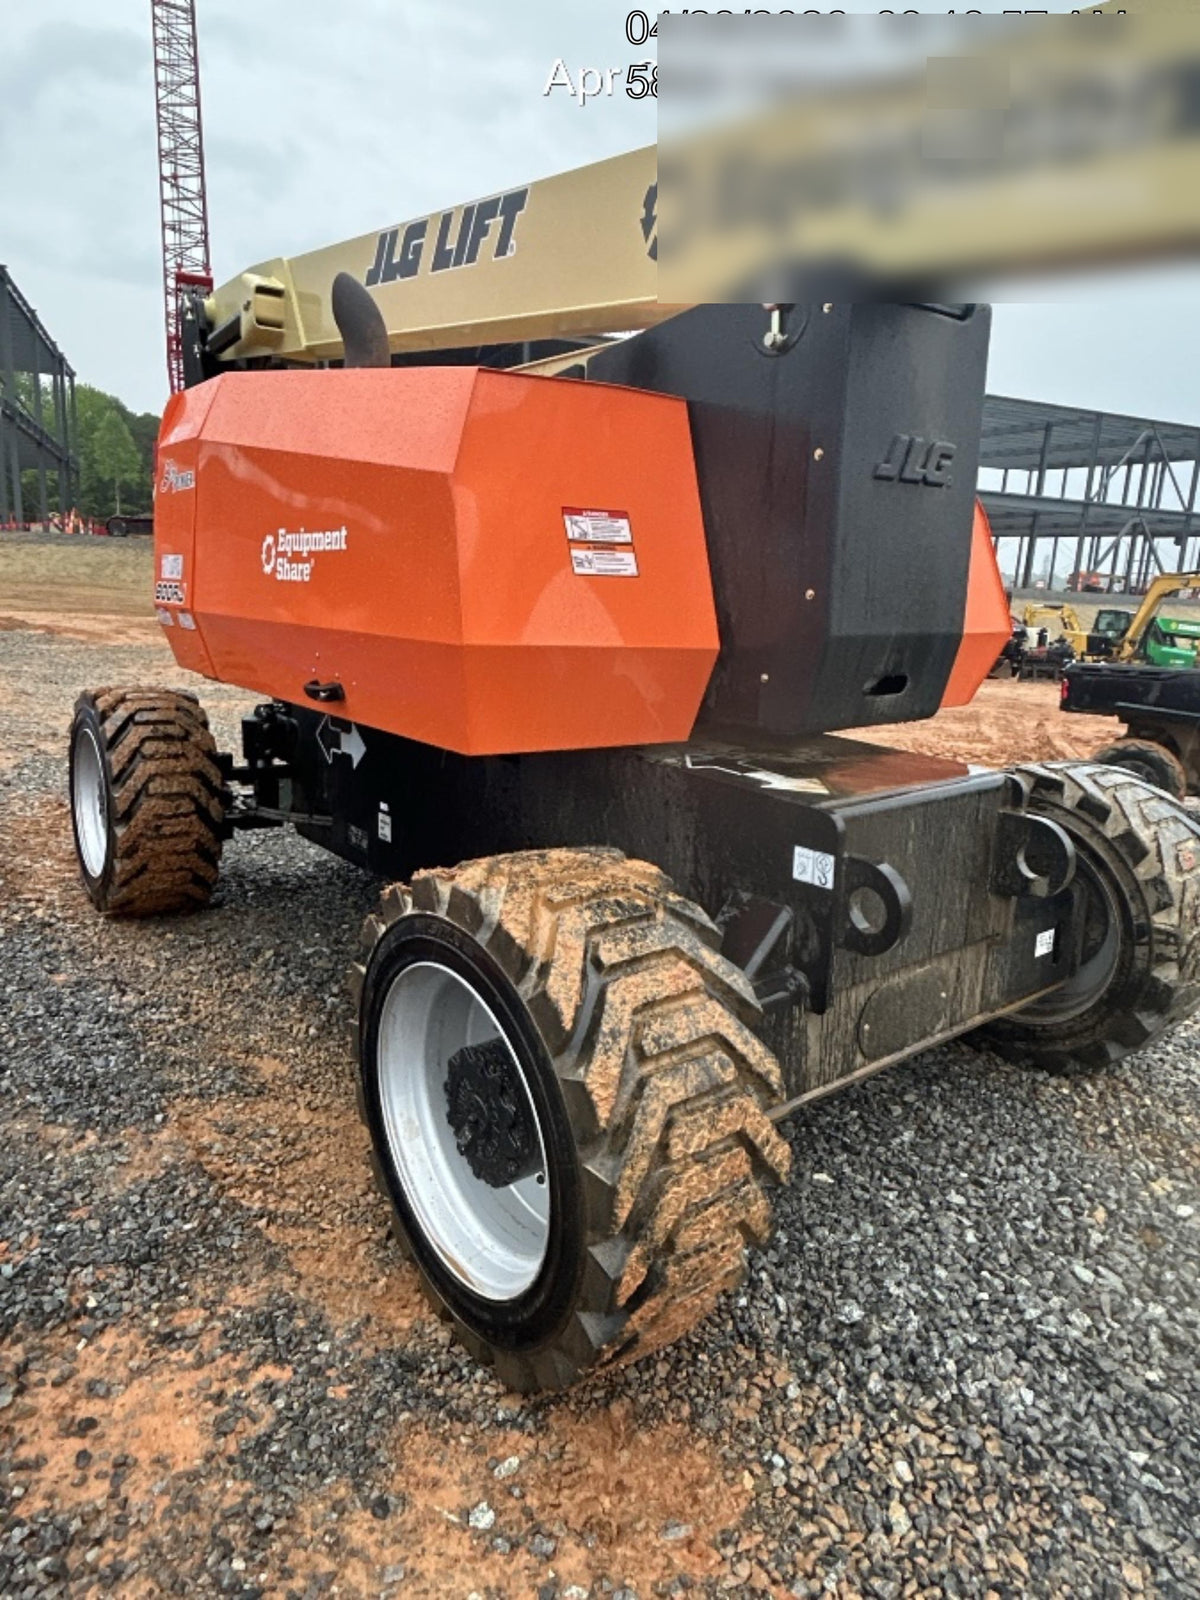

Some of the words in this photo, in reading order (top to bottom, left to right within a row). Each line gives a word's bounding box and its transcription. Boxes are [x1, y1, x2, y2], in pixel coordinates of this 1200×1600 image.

[365, 222, 429, 288] JLG
[428, 186, 530, 273] LIFT
[873, 434, 957, 487] JLG
[277, 526, 347, 557] Equipment
[276, 557, 311, 582] Share
